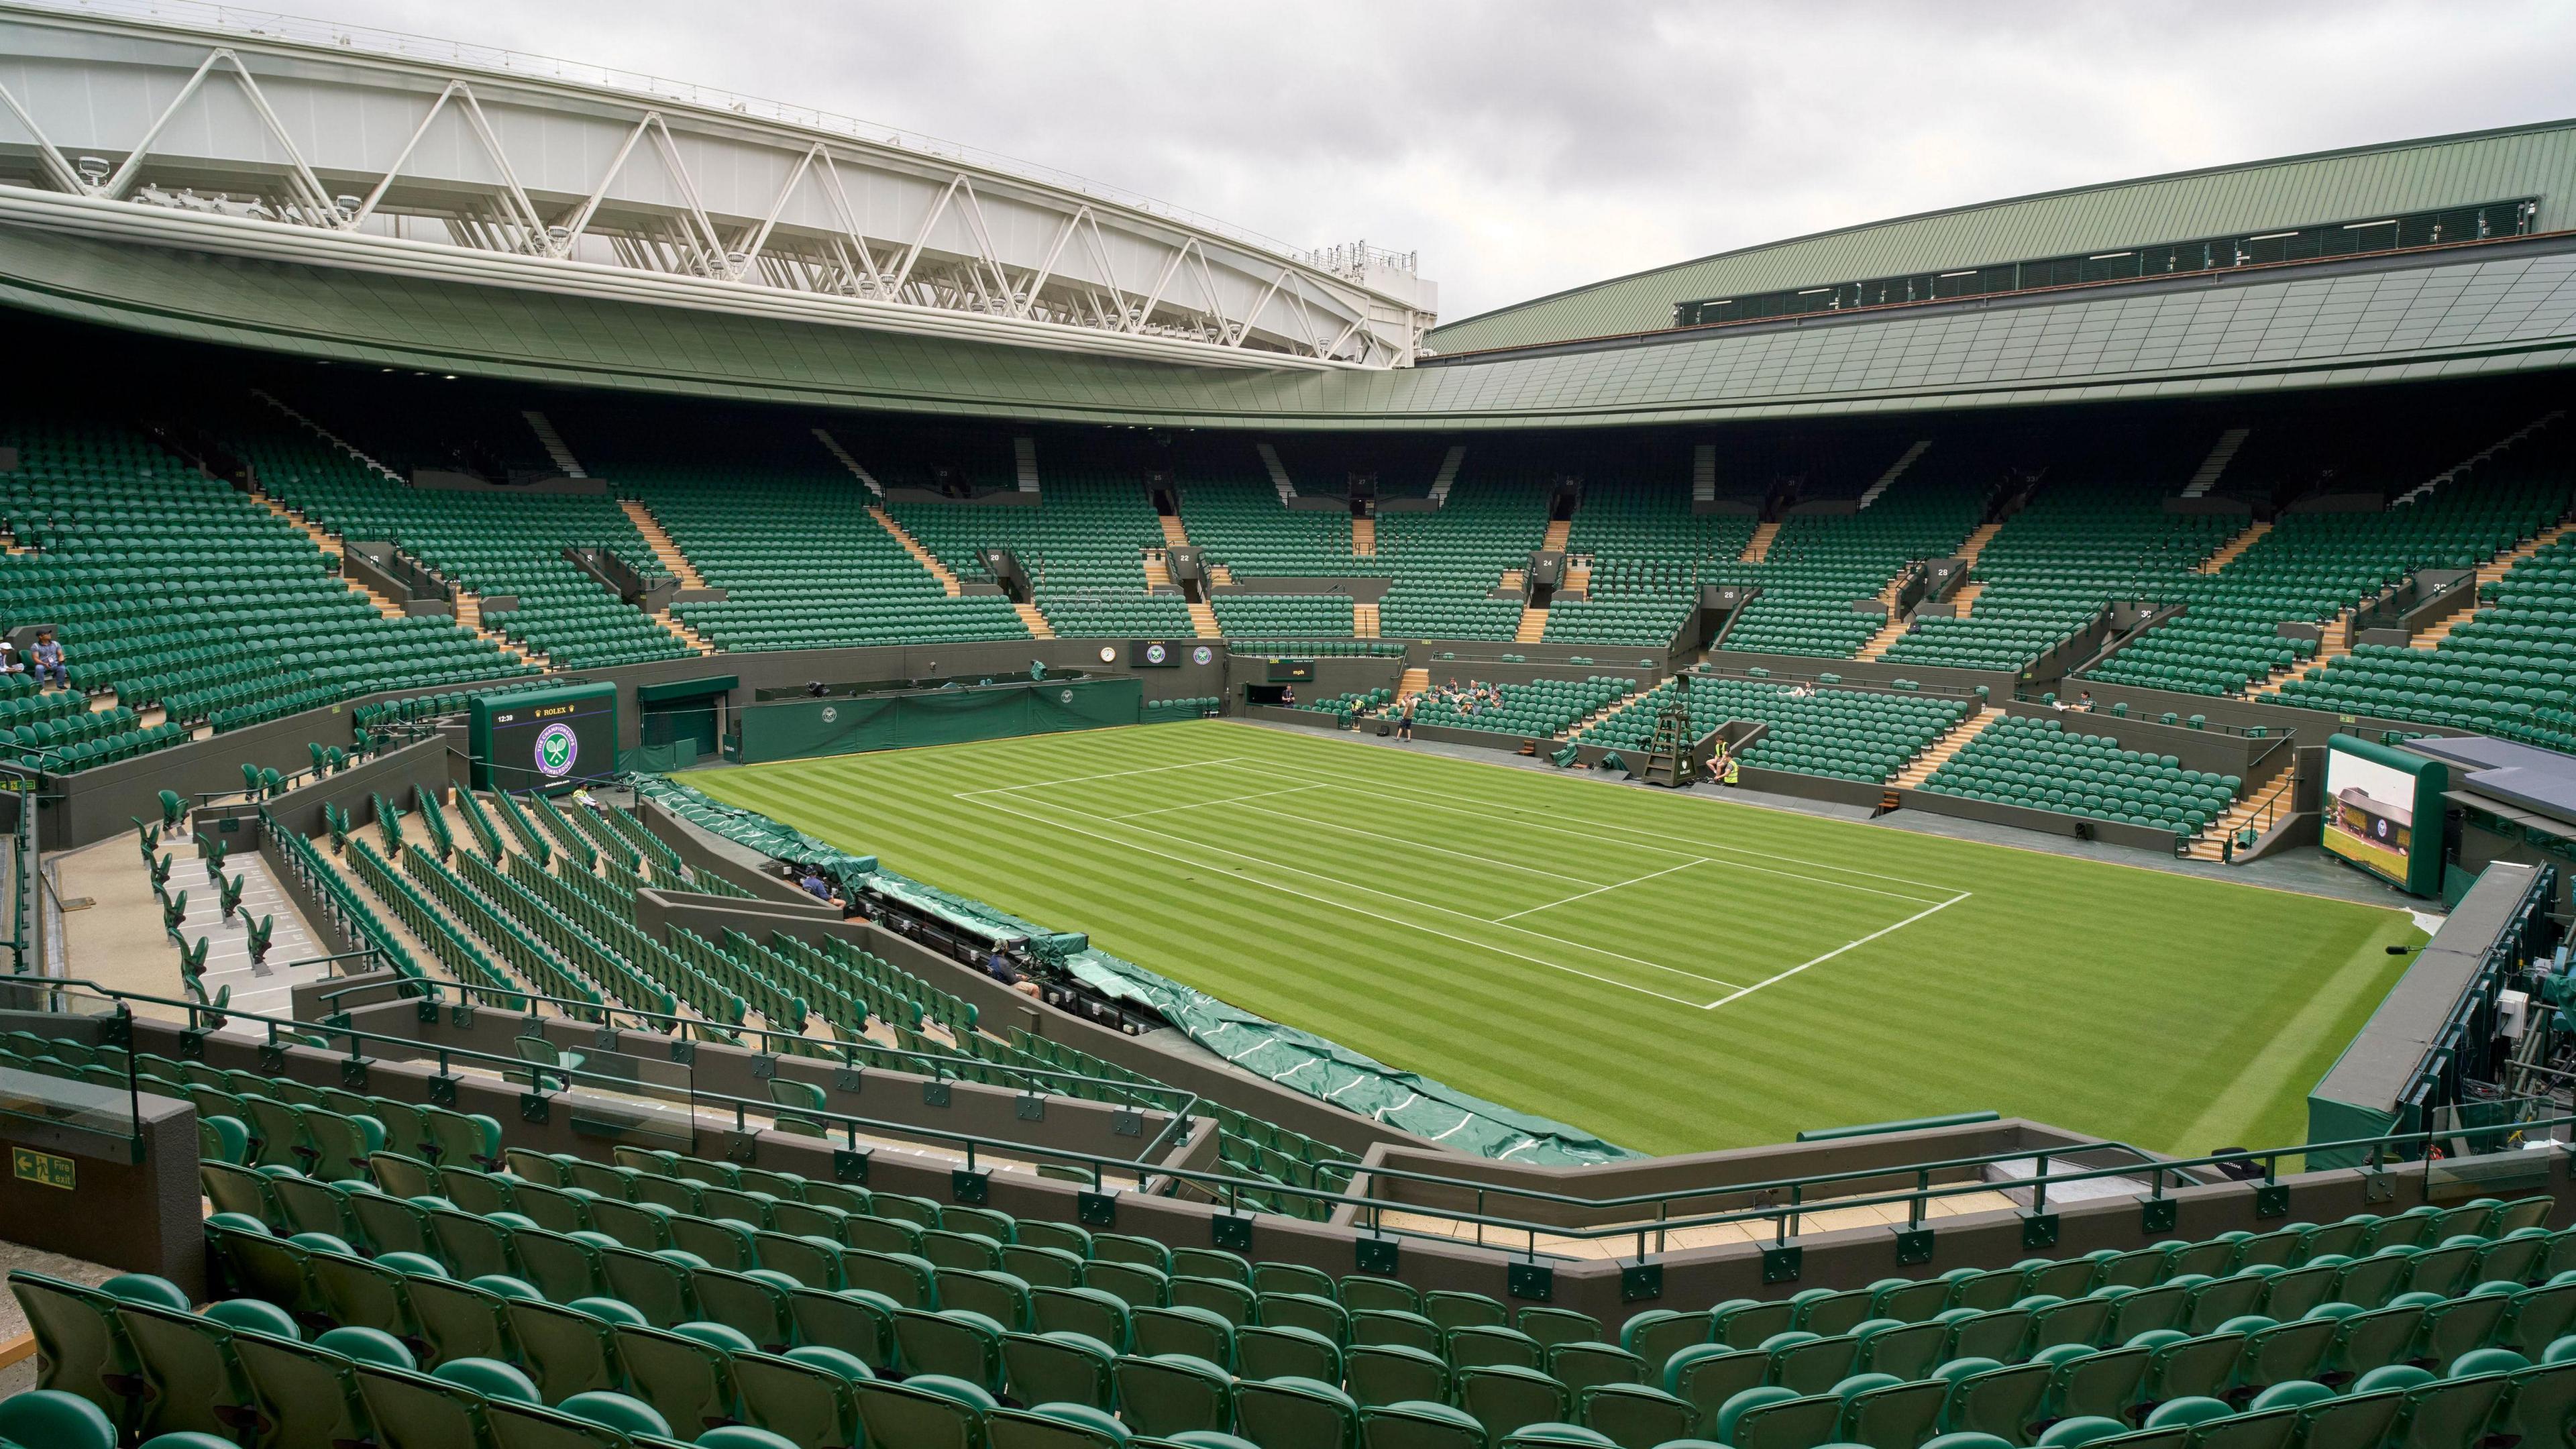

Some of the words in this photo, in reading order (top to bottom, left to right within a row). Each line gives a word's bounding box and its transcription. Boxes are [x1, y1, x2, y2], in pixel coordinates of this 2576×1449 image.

[370, 555, 378, 564] 16
[2141, 610, 2151, 618] 30
[544, 707, 566, 716] ROLEX
[498, 714, 513, 722] 12:39
[542, 727, 575, 746] CHAMPIONSHIPS
[543, 761, 571, 774] WIMBLEDON
[54, 1159, 70, 1172] Fire
[55, 1175, 70, 1185] exit
